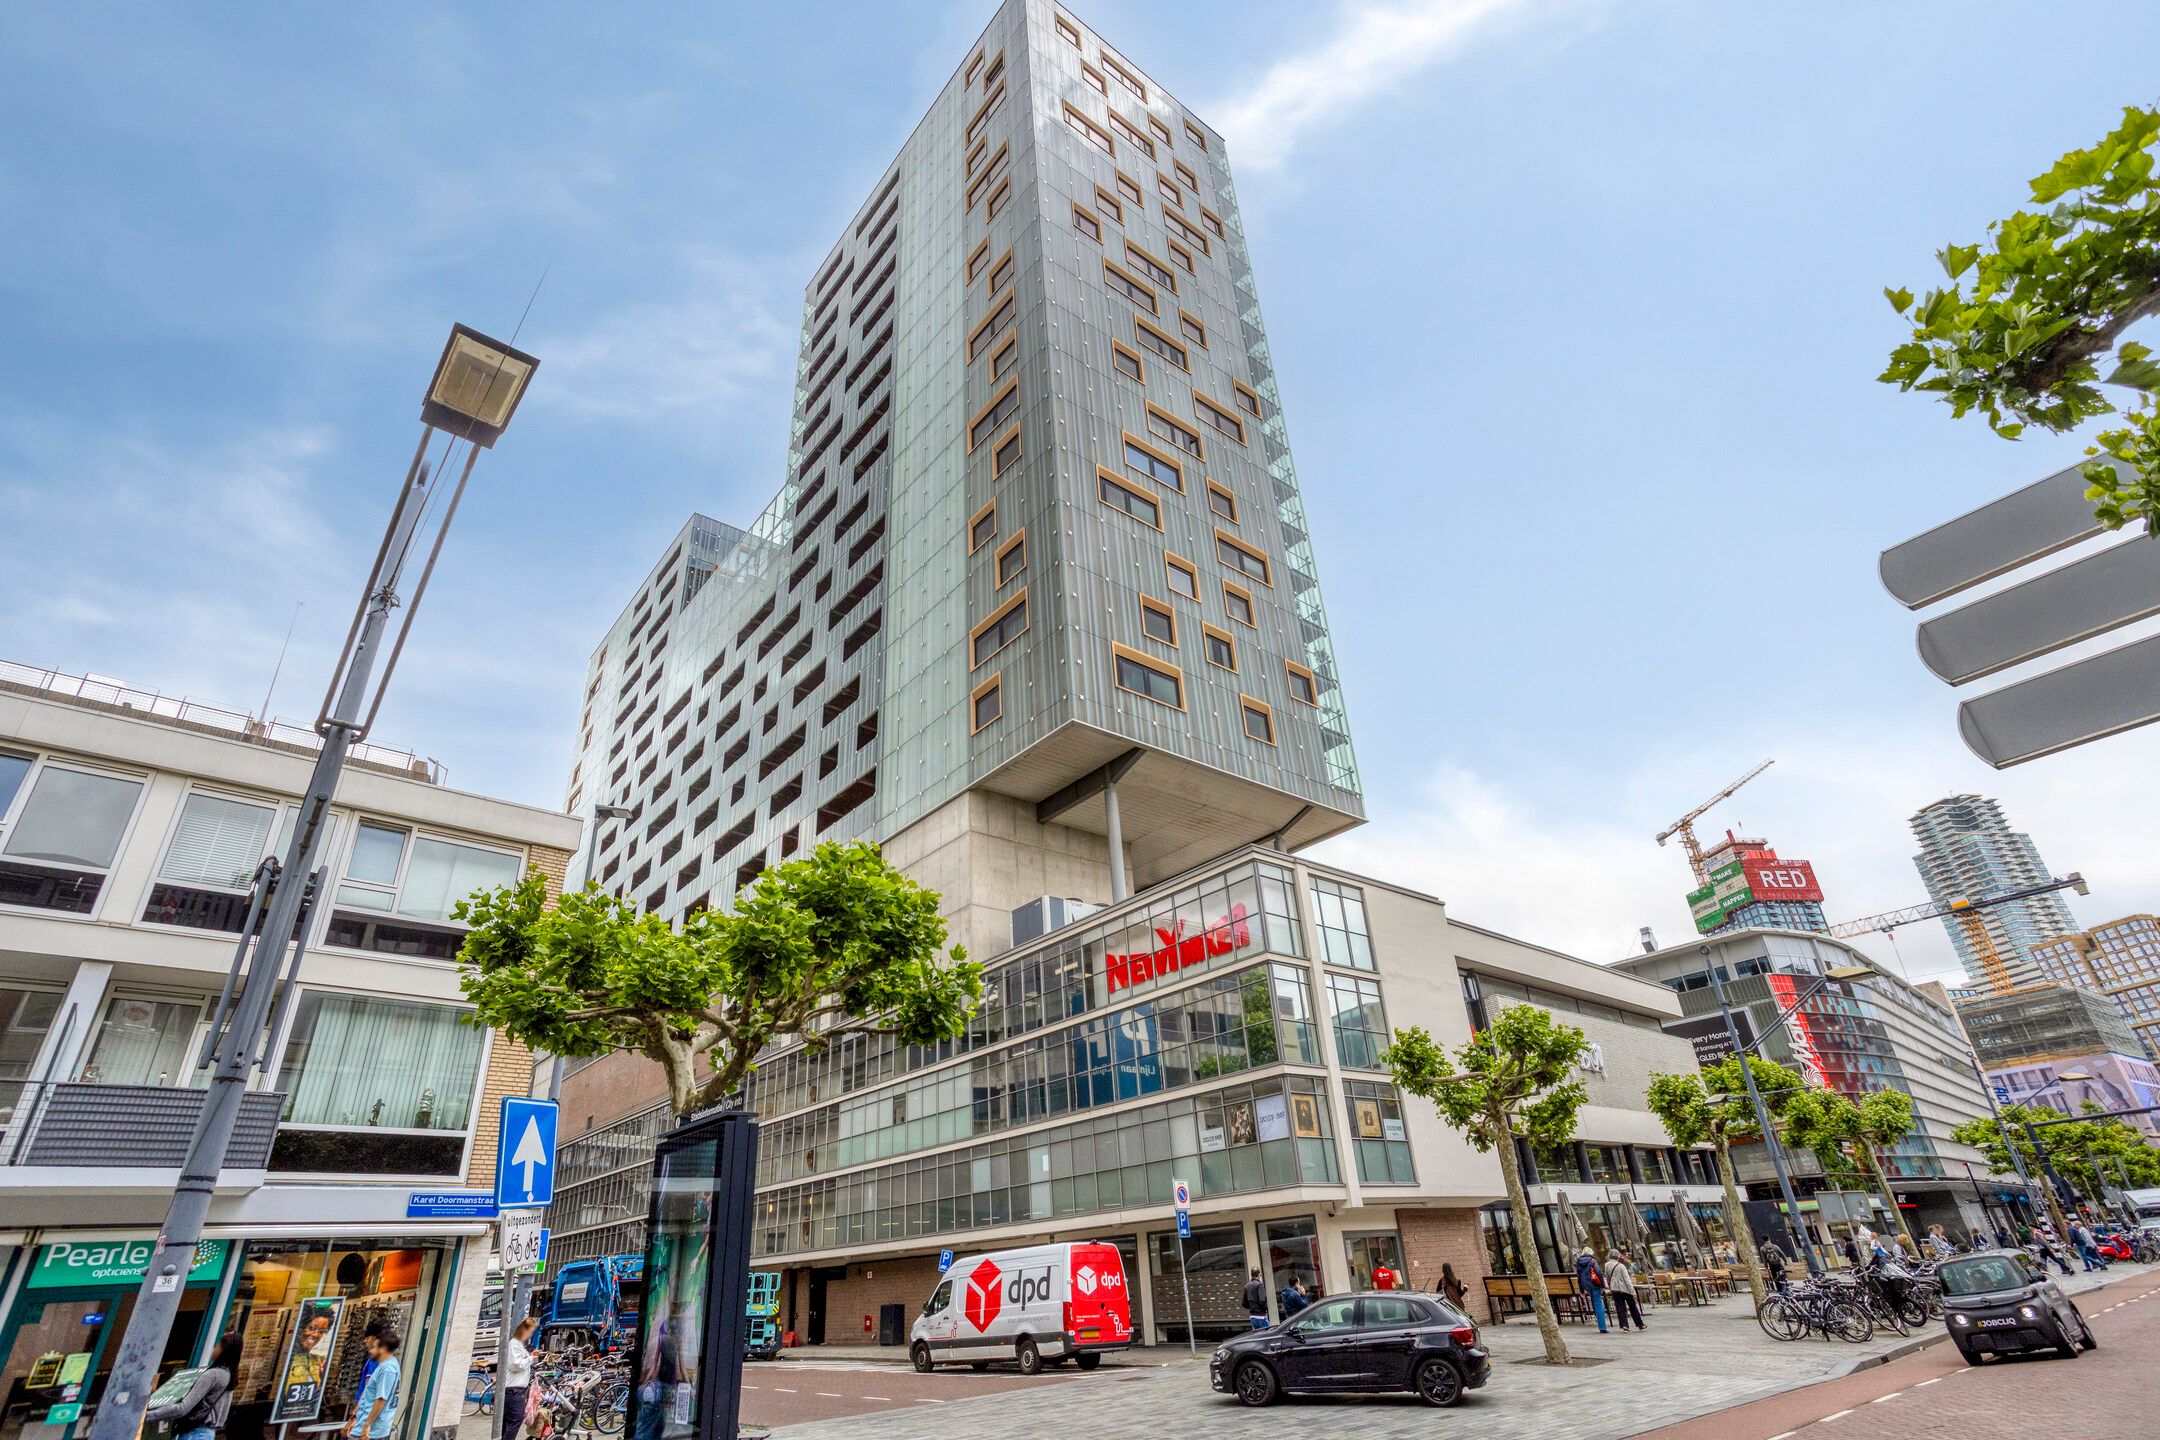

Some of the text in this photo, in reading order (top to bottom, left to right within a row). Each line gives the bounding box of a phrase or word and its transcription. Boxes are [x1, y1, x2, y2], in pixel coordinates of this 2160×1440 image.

[1759, 870, 1807, 888] RED
[1709, 1029, 1739, 1041] Momet
[1699, 1052, 1717, 1062] QLED
[413, 1195, 494, 1205] Karel Doormanstraa
[507, 1214, 541, 1229] uitgezonderd
[1180, 1213, 1186, 1226] P
[43, 1241, 149, 1267] Pearle
[943, 1252, 950, 1263] P
[92, 1267, 142, 1279] opticiens
[161, 1277, 172, 1285] 36
[1101, 1271, 1121, 1289] dpd
[1008, 1265, 1051, 1311] dpd
[1982, 1317, 2016, 1328] JOBCLIQ
[287, 1385, 301, 1402] 3
